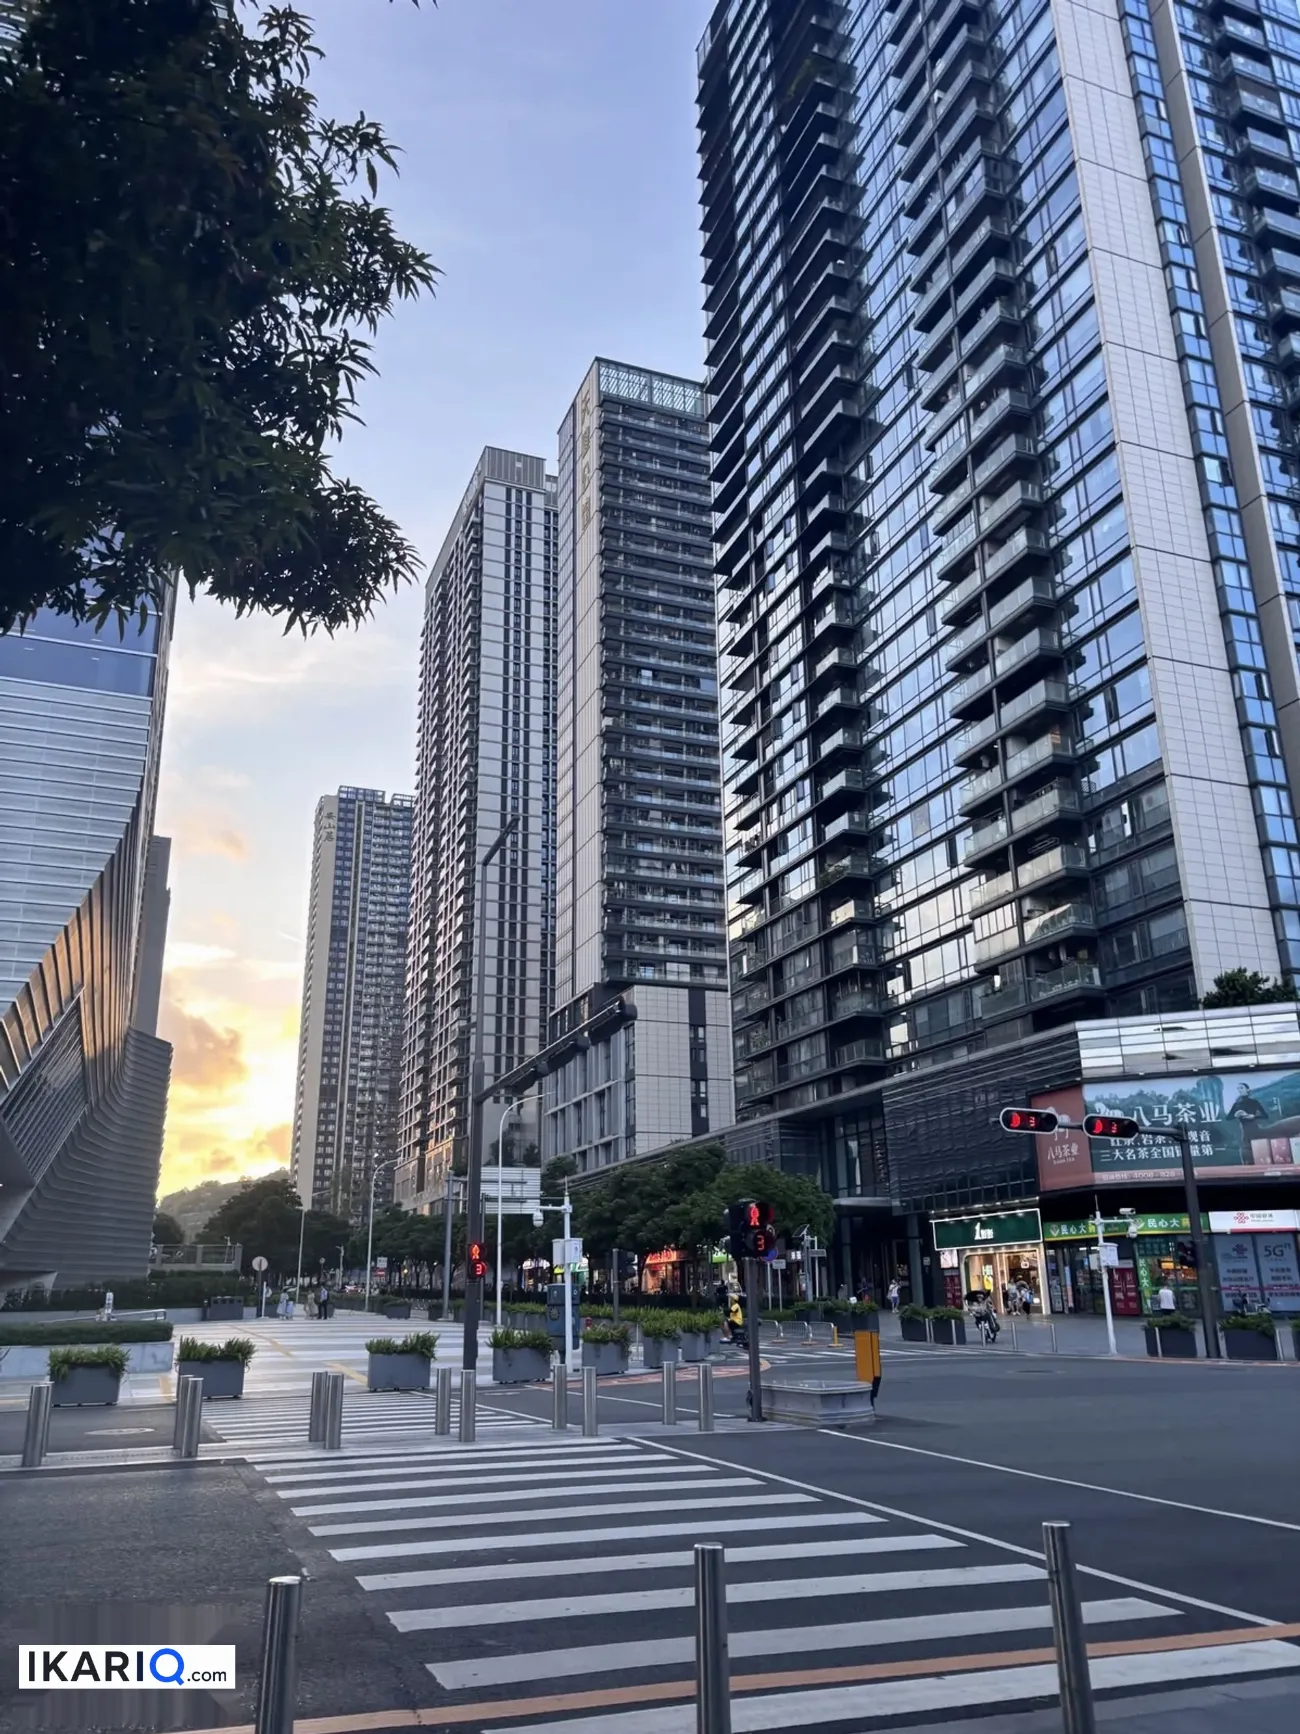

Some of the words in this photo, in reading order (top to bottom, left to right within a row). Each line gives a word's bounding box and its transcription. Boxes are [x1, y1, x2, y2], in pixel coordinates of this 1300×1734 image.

[1133, 1101, 1222, 1127] 八马茶业
[1061, 1221, 1098, 1235] 民心大药
[1148, 1216, 1203, 1229] 民心大药
[757, 1235, 764, 1250] 3
[476, 1263, 482, 1275] 3
